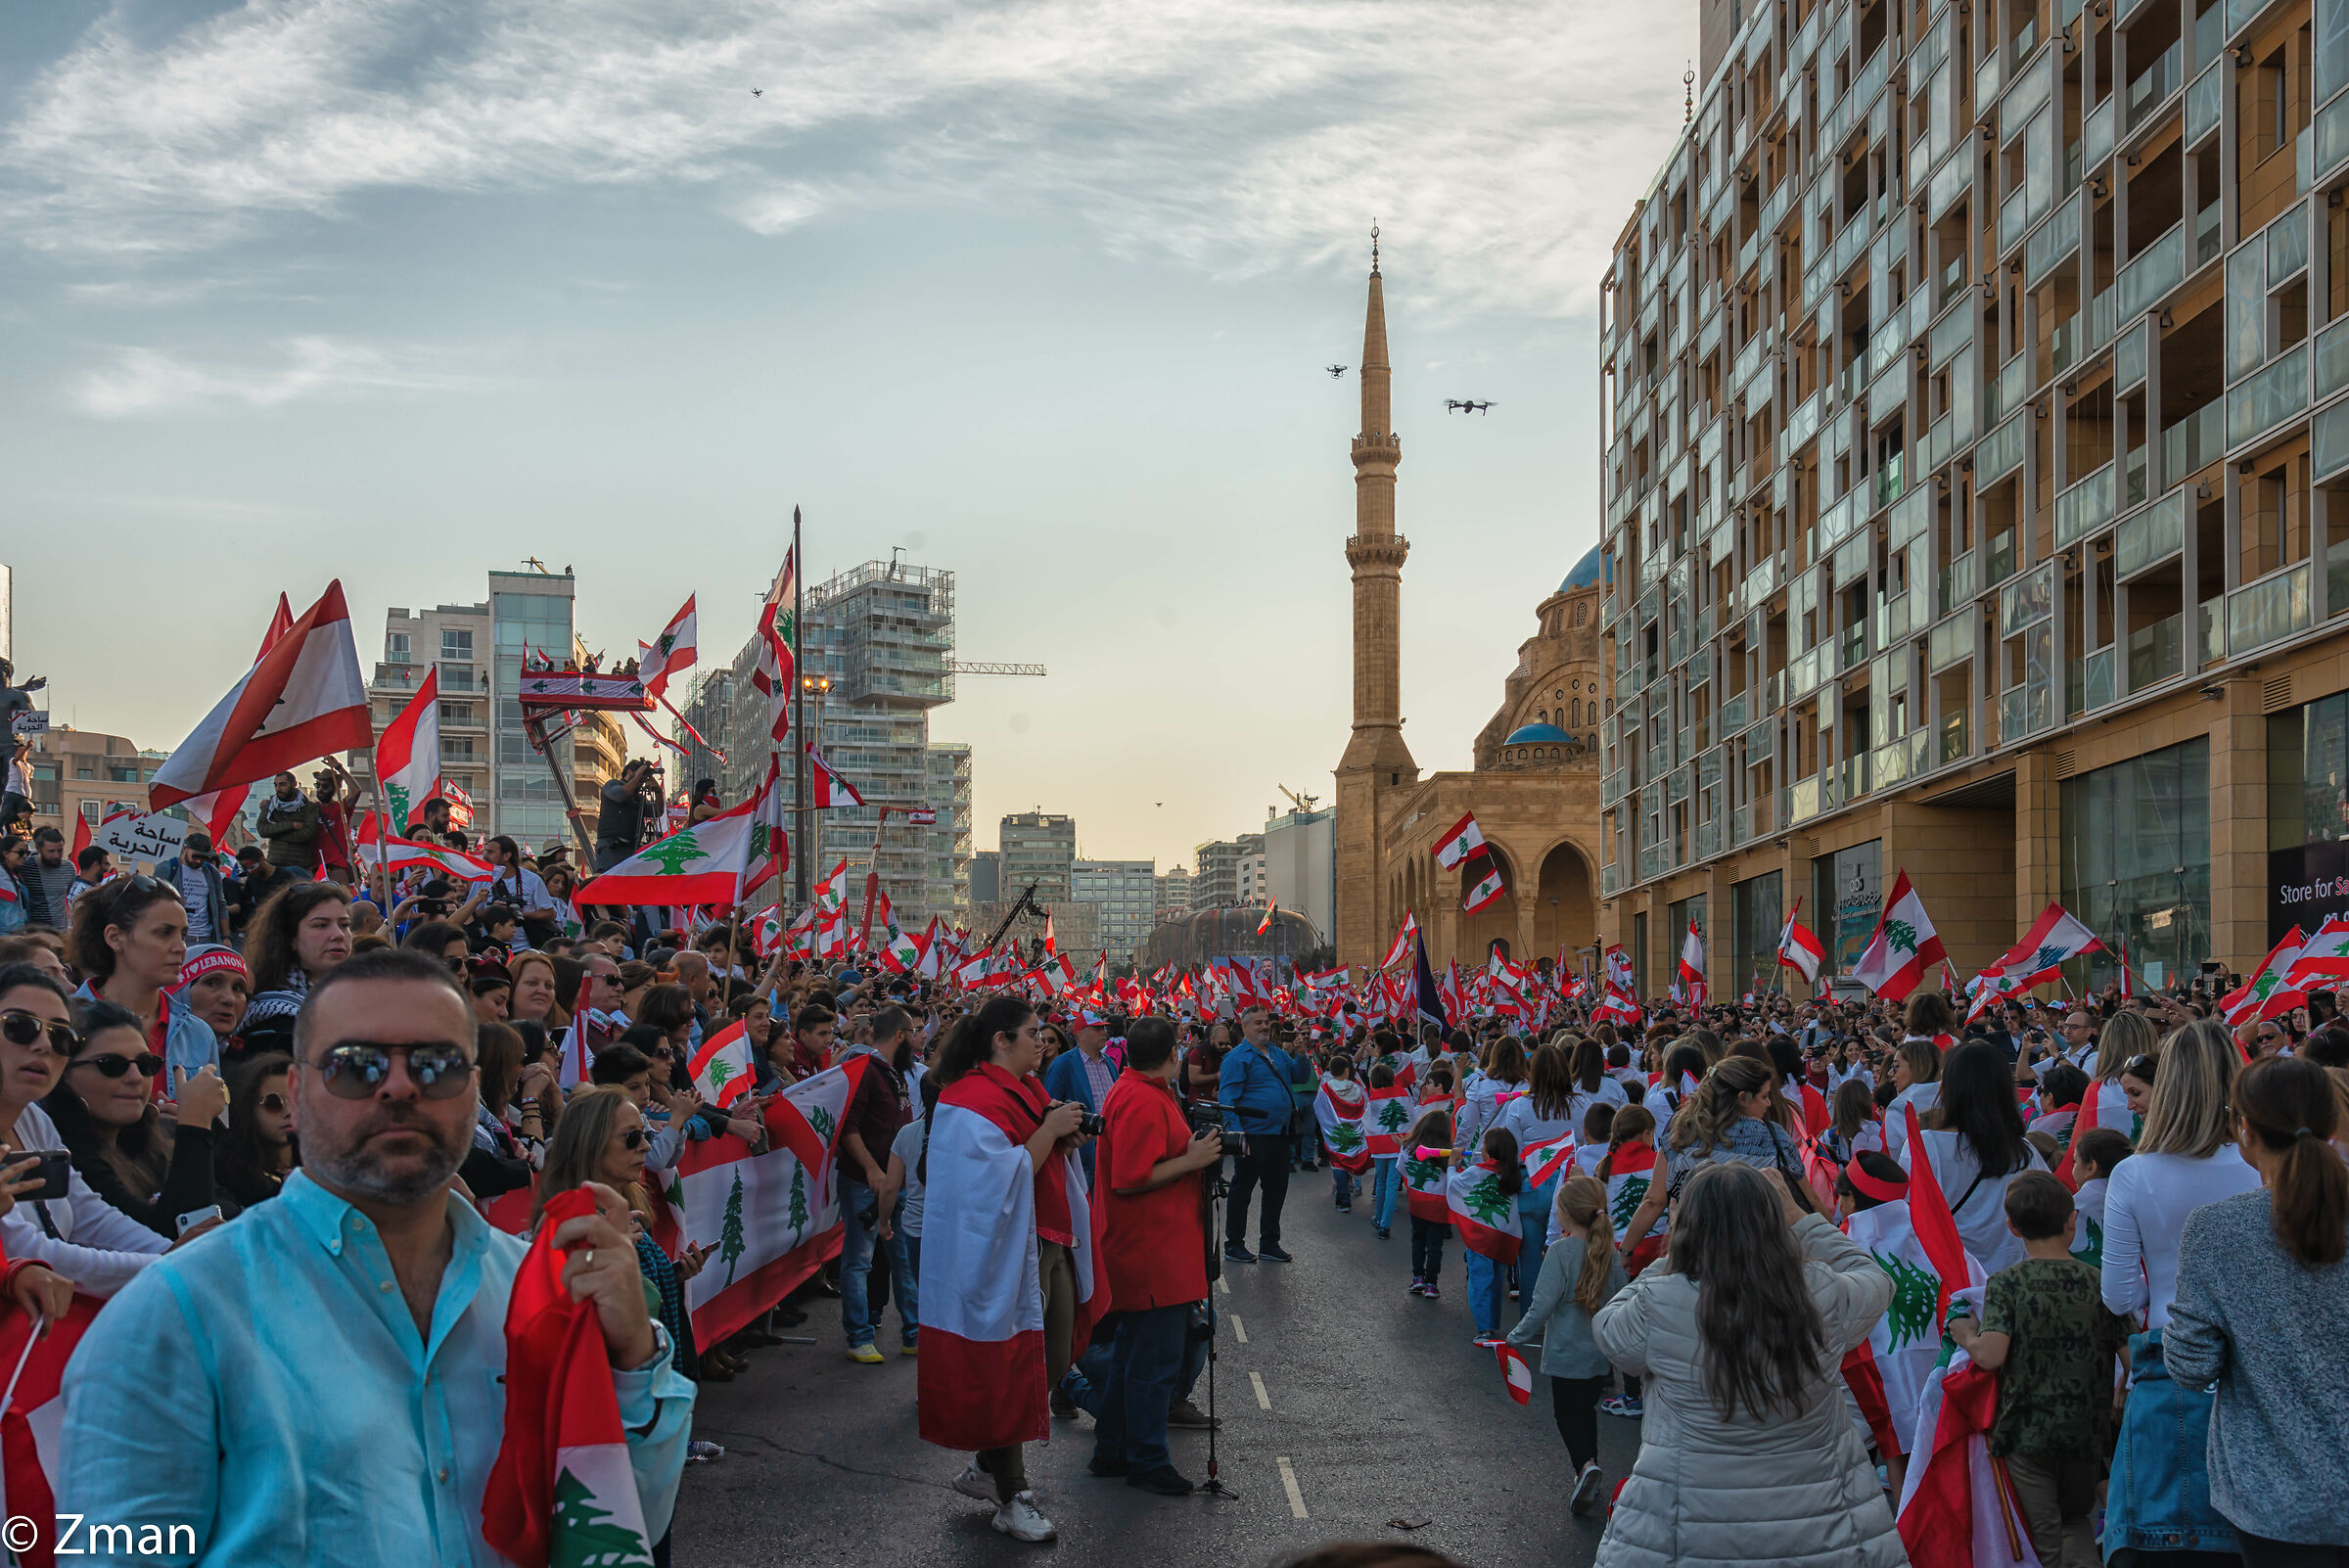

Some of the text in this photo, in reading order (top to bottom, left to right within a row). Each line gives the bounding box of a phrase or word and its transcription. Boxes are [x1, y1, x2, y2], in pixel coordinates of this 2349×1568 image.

[17, 723, 43, 733] الحرية
[109, 831, 166, 858] الحرية
[134, 821, 181, 846] ساحة
[2280, 885, 2312, 904] Store
[2315, 877, 2333, 899] for
[184, 955, 243, 979] I LEBANON
